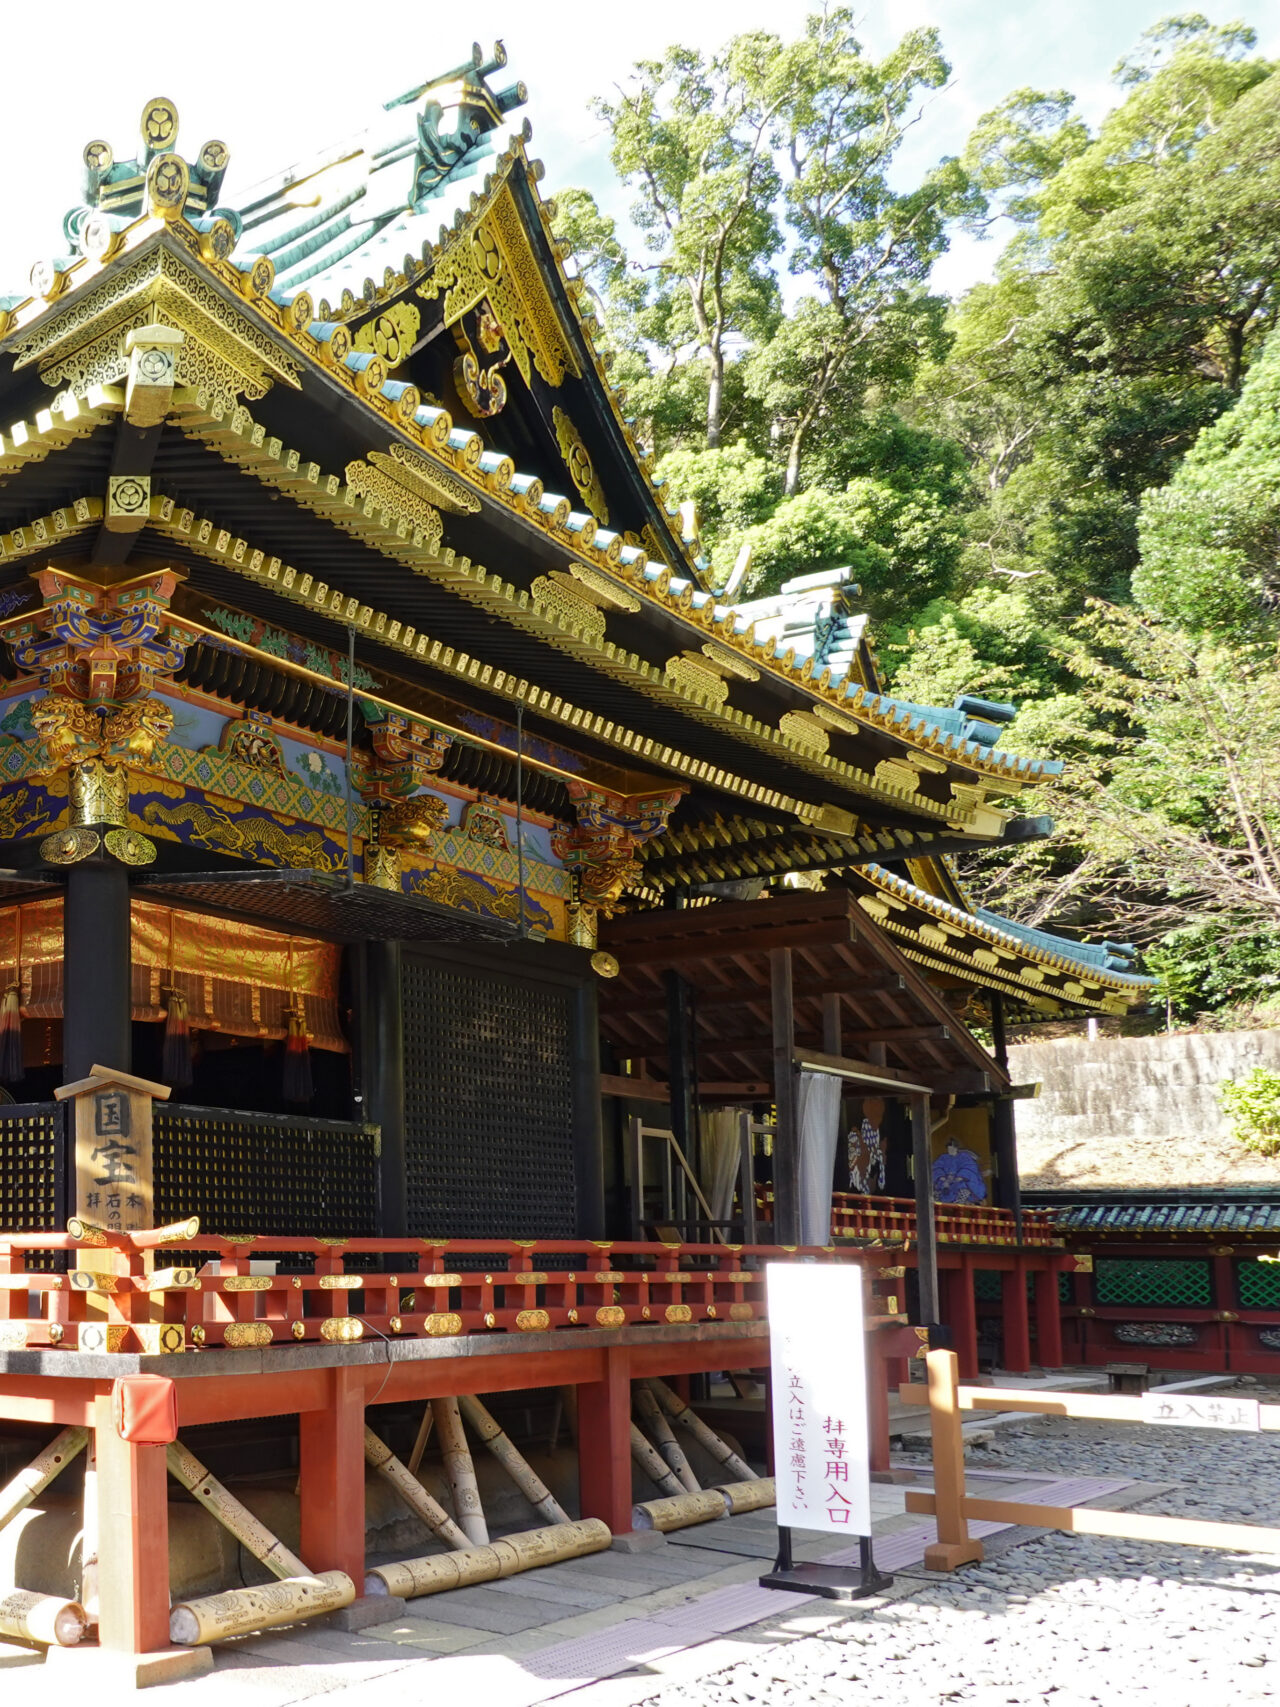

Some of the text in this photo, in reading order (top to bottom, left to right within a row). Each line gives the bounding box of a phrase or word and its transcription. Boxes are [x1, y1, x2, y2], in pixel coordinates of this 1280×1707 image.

[91, 1092, 137, 1185] 国宝
[1152, 1402, 1249, 1424] 立入禁止
[823, 1416, 852, 1523] 拝専用入口
